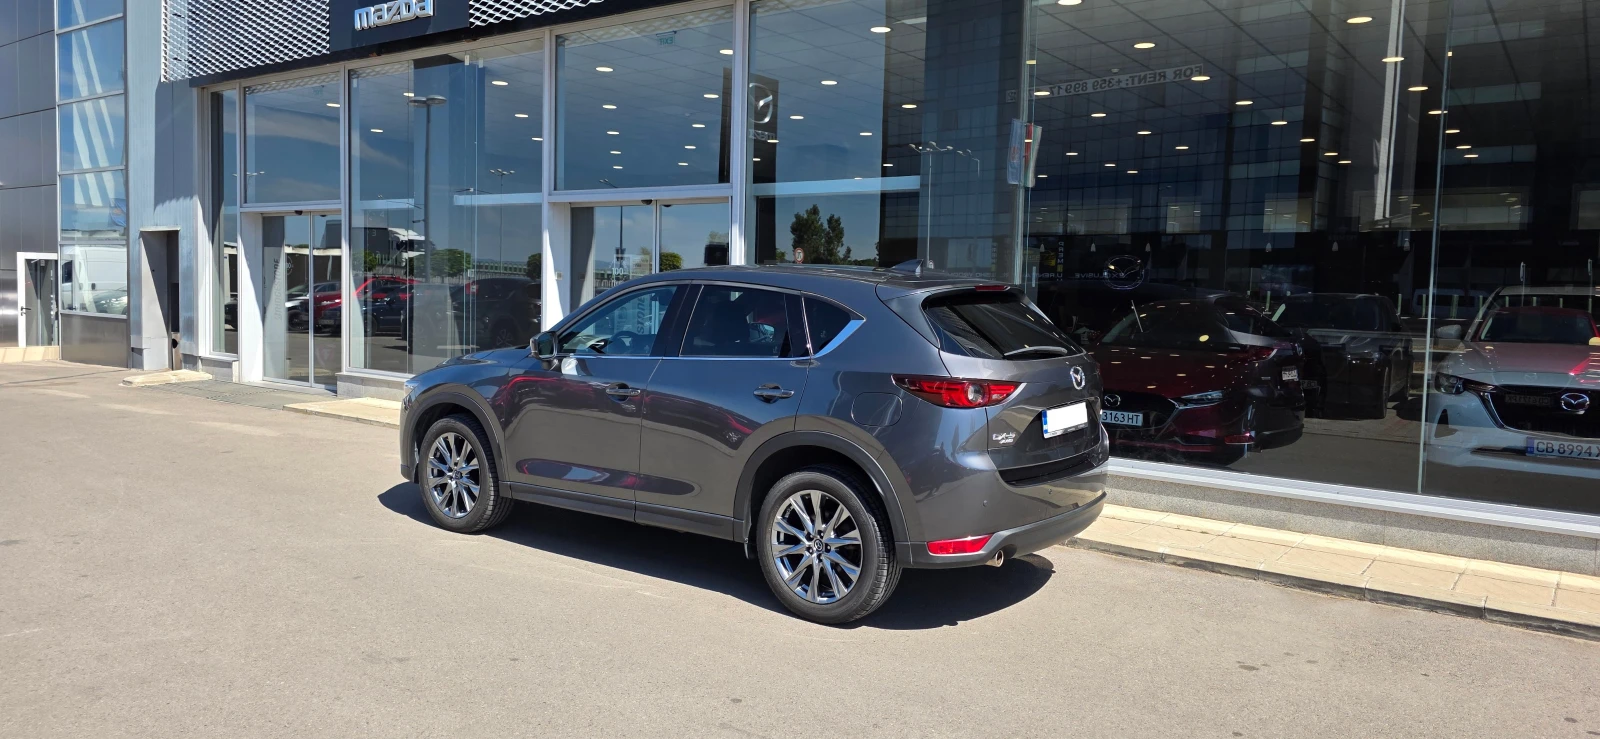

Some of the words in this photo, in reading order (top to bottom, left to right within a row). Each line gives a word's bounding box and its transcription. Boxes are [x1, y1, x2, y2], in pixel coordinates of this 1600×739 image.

[354, 0, 433, 31] mazda
[1102, 411, 1125, 423] 3163
[1127, 413, 1140, 424] HT
[1536, 441, 1555, 453] CB
[1557, 443, 1592, 457] 8994
